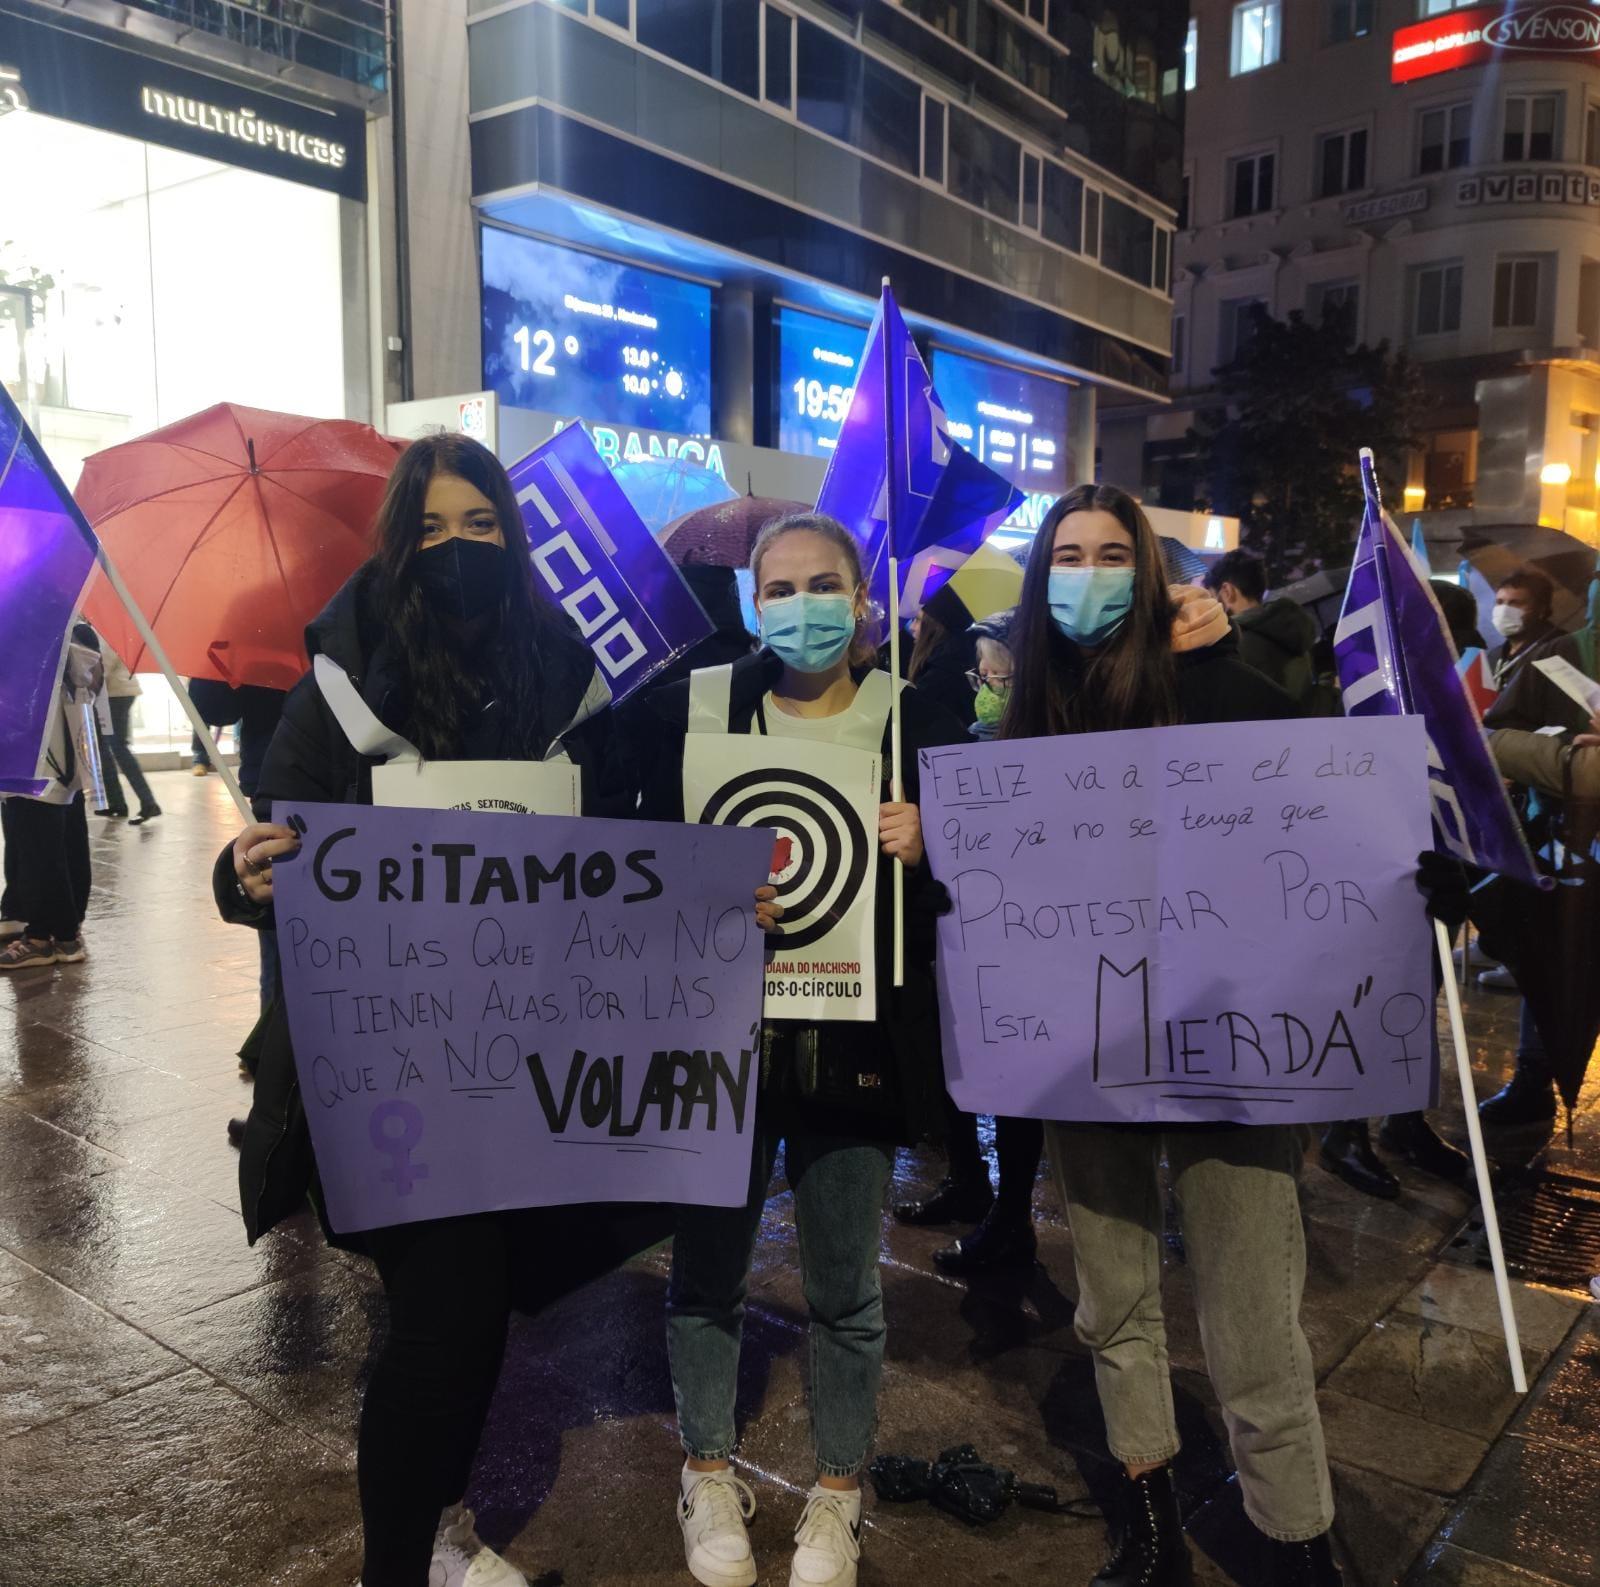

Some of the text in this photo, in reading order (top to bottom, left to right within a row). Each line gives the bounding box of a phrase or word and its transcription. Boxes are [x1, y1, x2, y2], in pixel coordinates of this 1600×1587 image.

[1497, 18, 1600, 43] SVENSON
[1065, 765, 1105, 791] va
[1122, 764, 1143, 788] a
[1166, 759, 1224, 787] ser
[1252, 747, 1291, 782] el
[477, 799, 528, 814] SEXTORSIÓN
[943, 804, 1329, 860] que ya no se tenga que
[951, 850, 1378, 952] PROTESTAR POR
[286, 917, 362, 970] POR
[388, 923, 448, 967] LAS
[472, 917, 533, 967] QUE
[674, 905, 748, 963] NO
[766, 961, 861, 975] DIANA DO MACHISMO
[311, 989, 453, 1034] TIENEN
[570, 975, 625, 1020] POR
[644, 974, 716, 1019] LAS
[977, 965, 1051, 1044] ESTA
[312, 1055, 378, 1109] QUE
[392, 1046, 424, 1092] YA
[444, 1031, 520, 1083] NO
